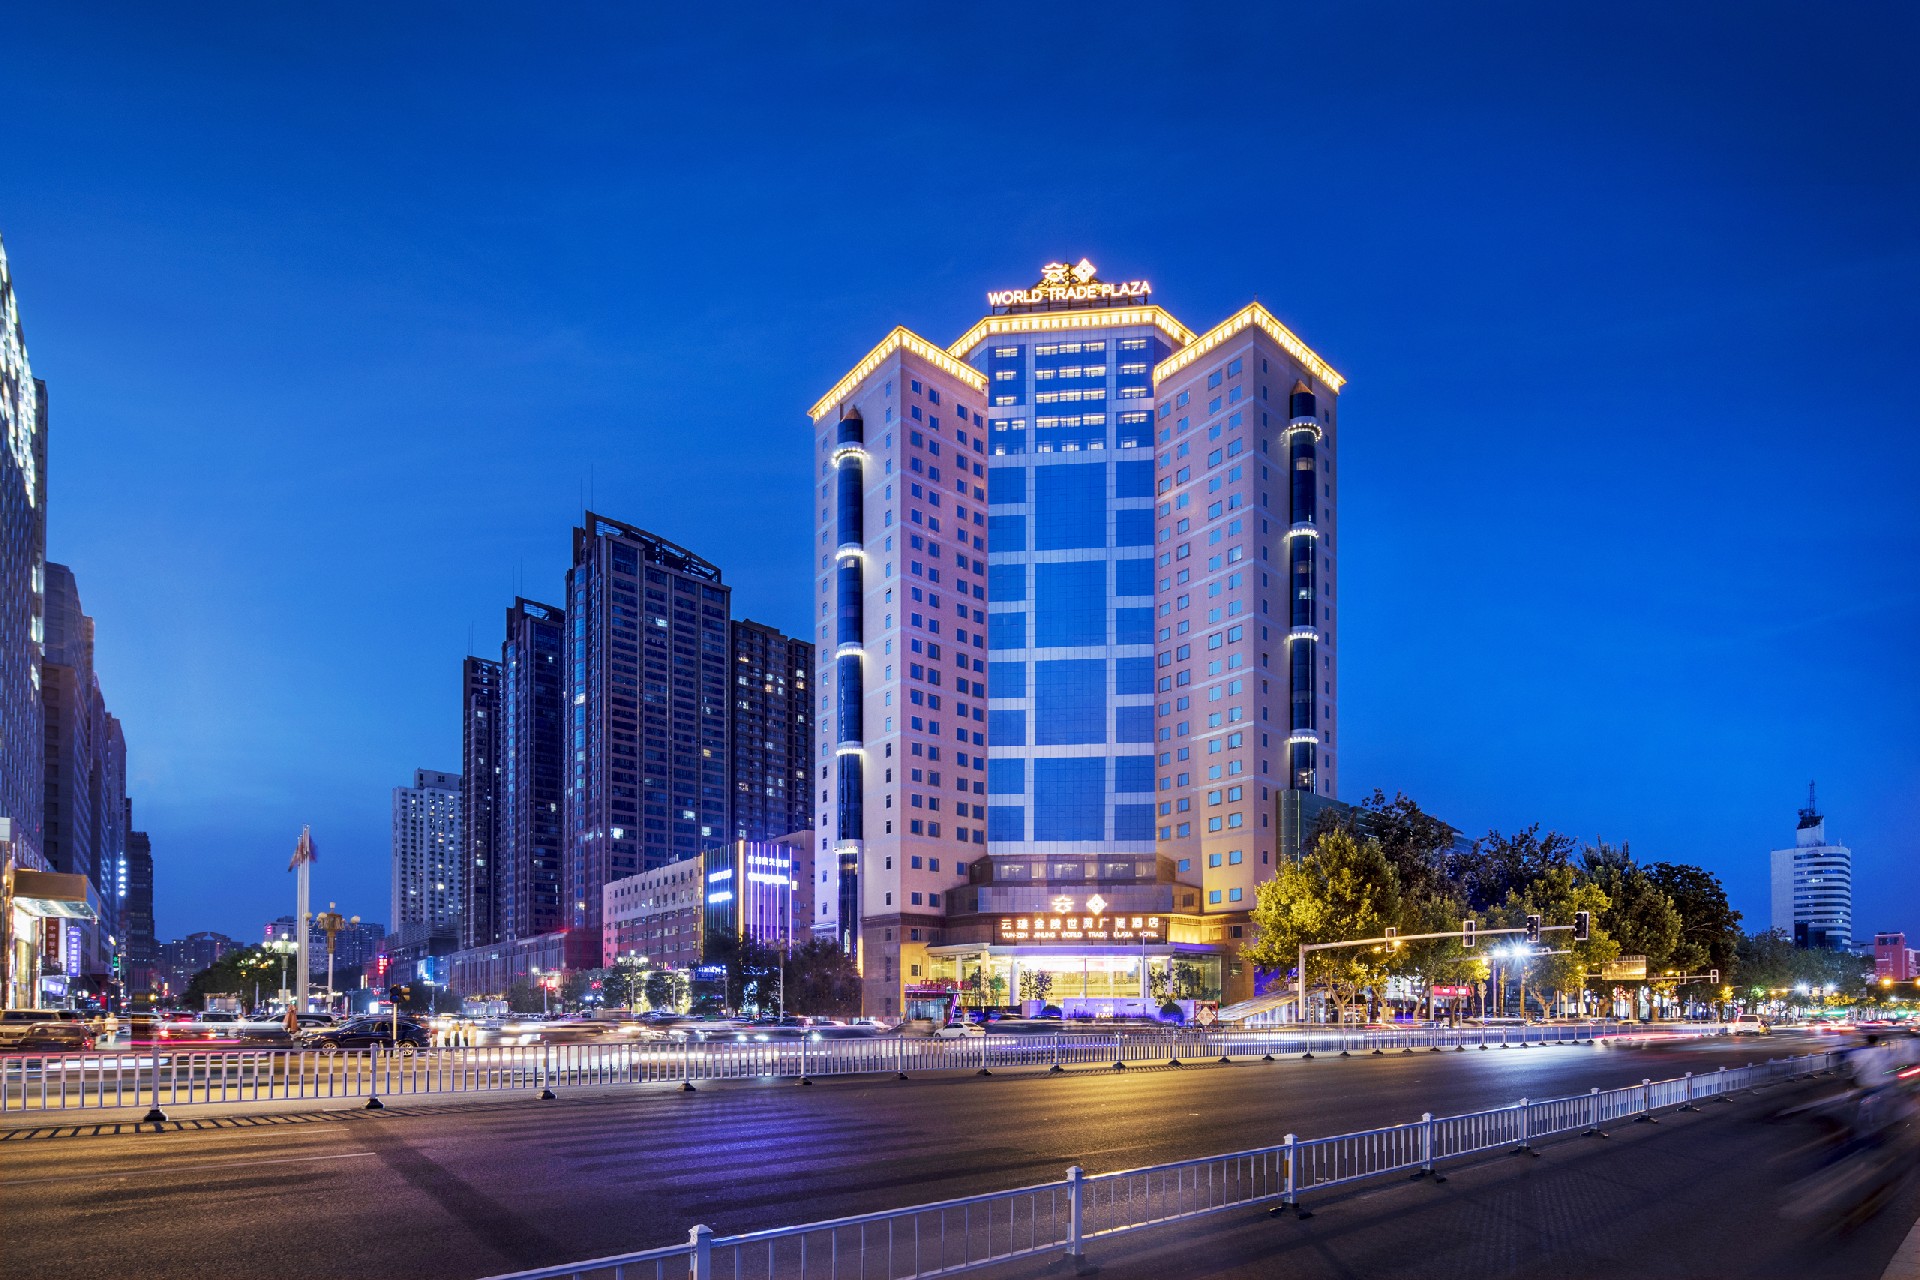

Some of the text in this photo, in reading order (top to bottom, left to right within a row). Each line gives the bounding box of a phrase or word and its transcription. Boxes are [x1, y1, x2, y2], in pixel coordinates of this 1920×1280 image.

[988, 281, 1152, 306] WORLD TRADE PLAZA
[1033, 931, 1056, 939] JINLING
[1061, 931, 1083, 939] WORLD
[1088, 931, 1108, 939] TRADE
[1139, 931, 1159, 939] HOTEL
